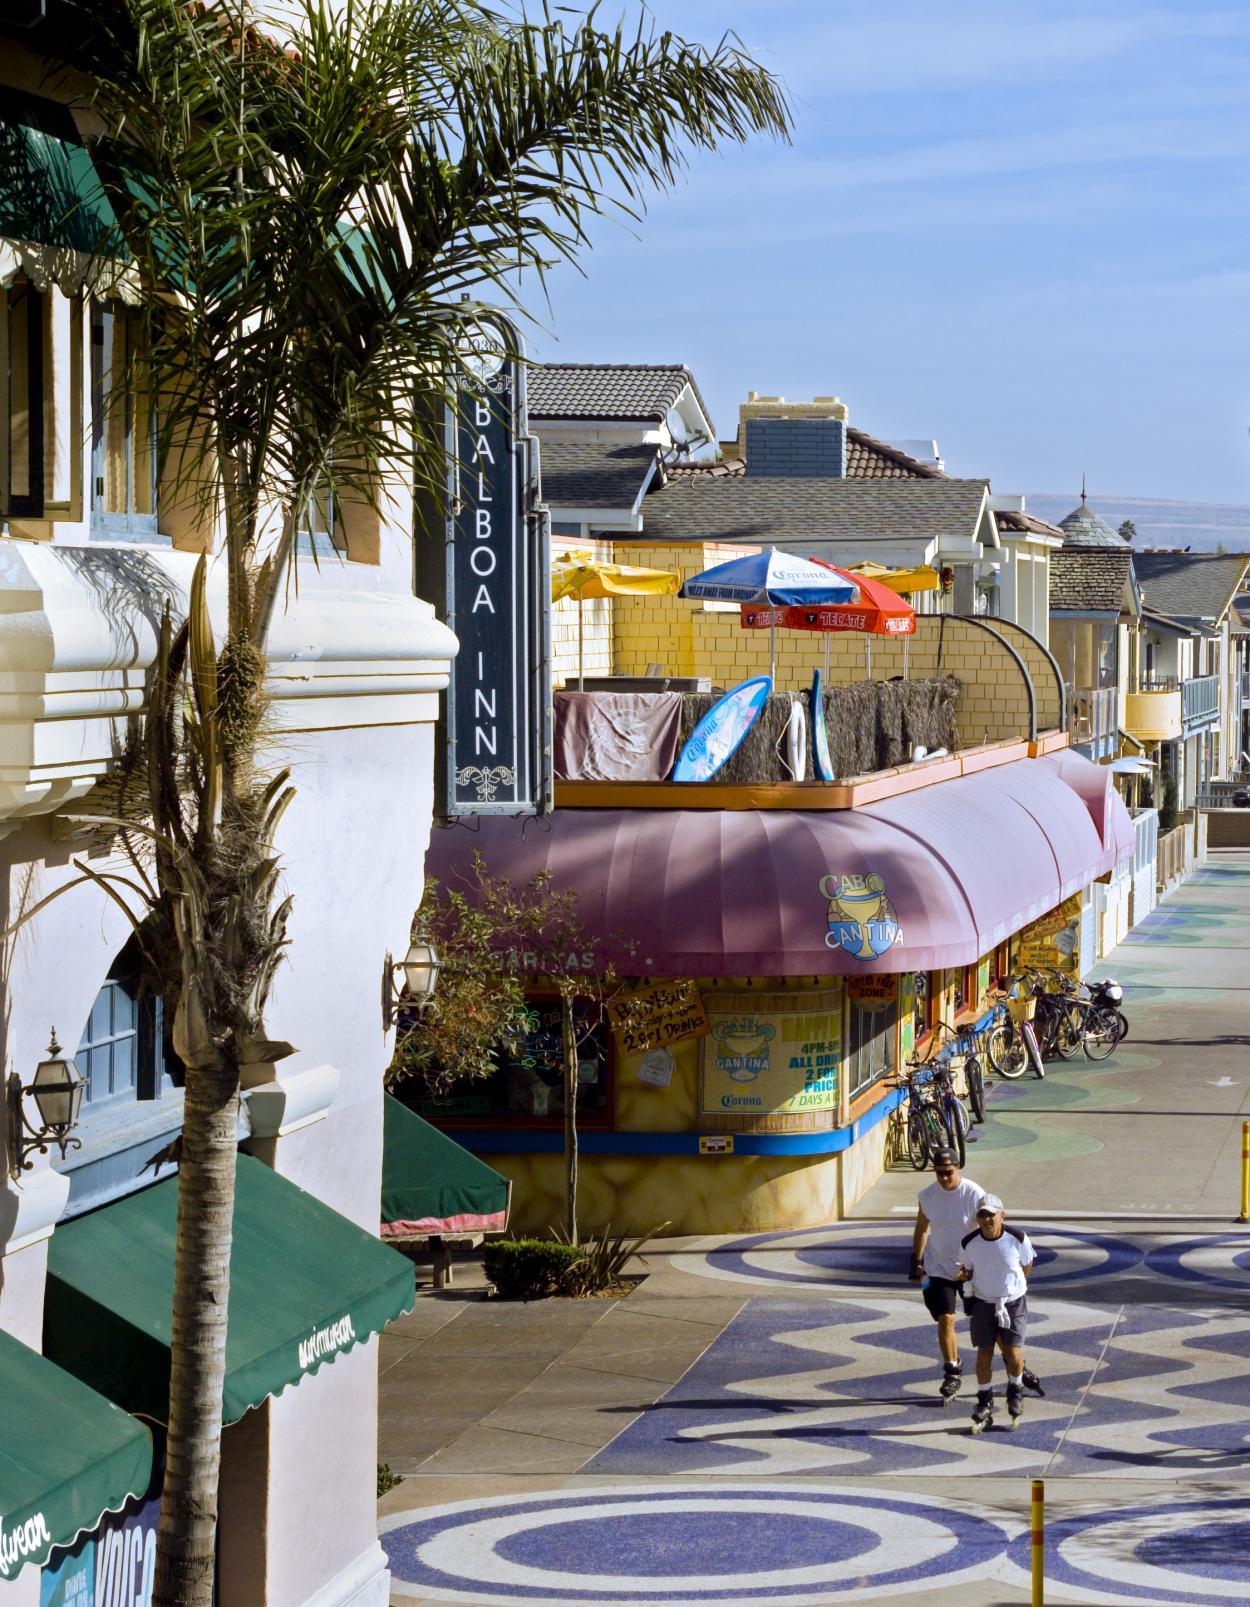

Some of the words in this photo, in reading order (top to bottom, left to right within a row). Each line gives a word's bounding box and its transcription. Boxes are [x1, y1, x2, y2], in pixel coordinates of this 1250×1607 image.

[470, 397, 497, 614] BALBOA
[772, 569, 829, 579] Corona
[820, 611, 866, 628] TECATE
[474, 651, 497, 755] INN
[818, 872, 886, 900] CABO
[825, 923, 905, 949] CANTINA
[623, 1034, 638, 1053] 2
[664, 1017, 704, 1040] DRINKS
[716, 1057, 769, 1071] CANTINA
[788, 1055, 813, 1069] ALL
[806, 1069, 814, 1081] 2
[721, 1094, 762, 1107] Corona
[800, 1094, 822, 1106] DAYS
